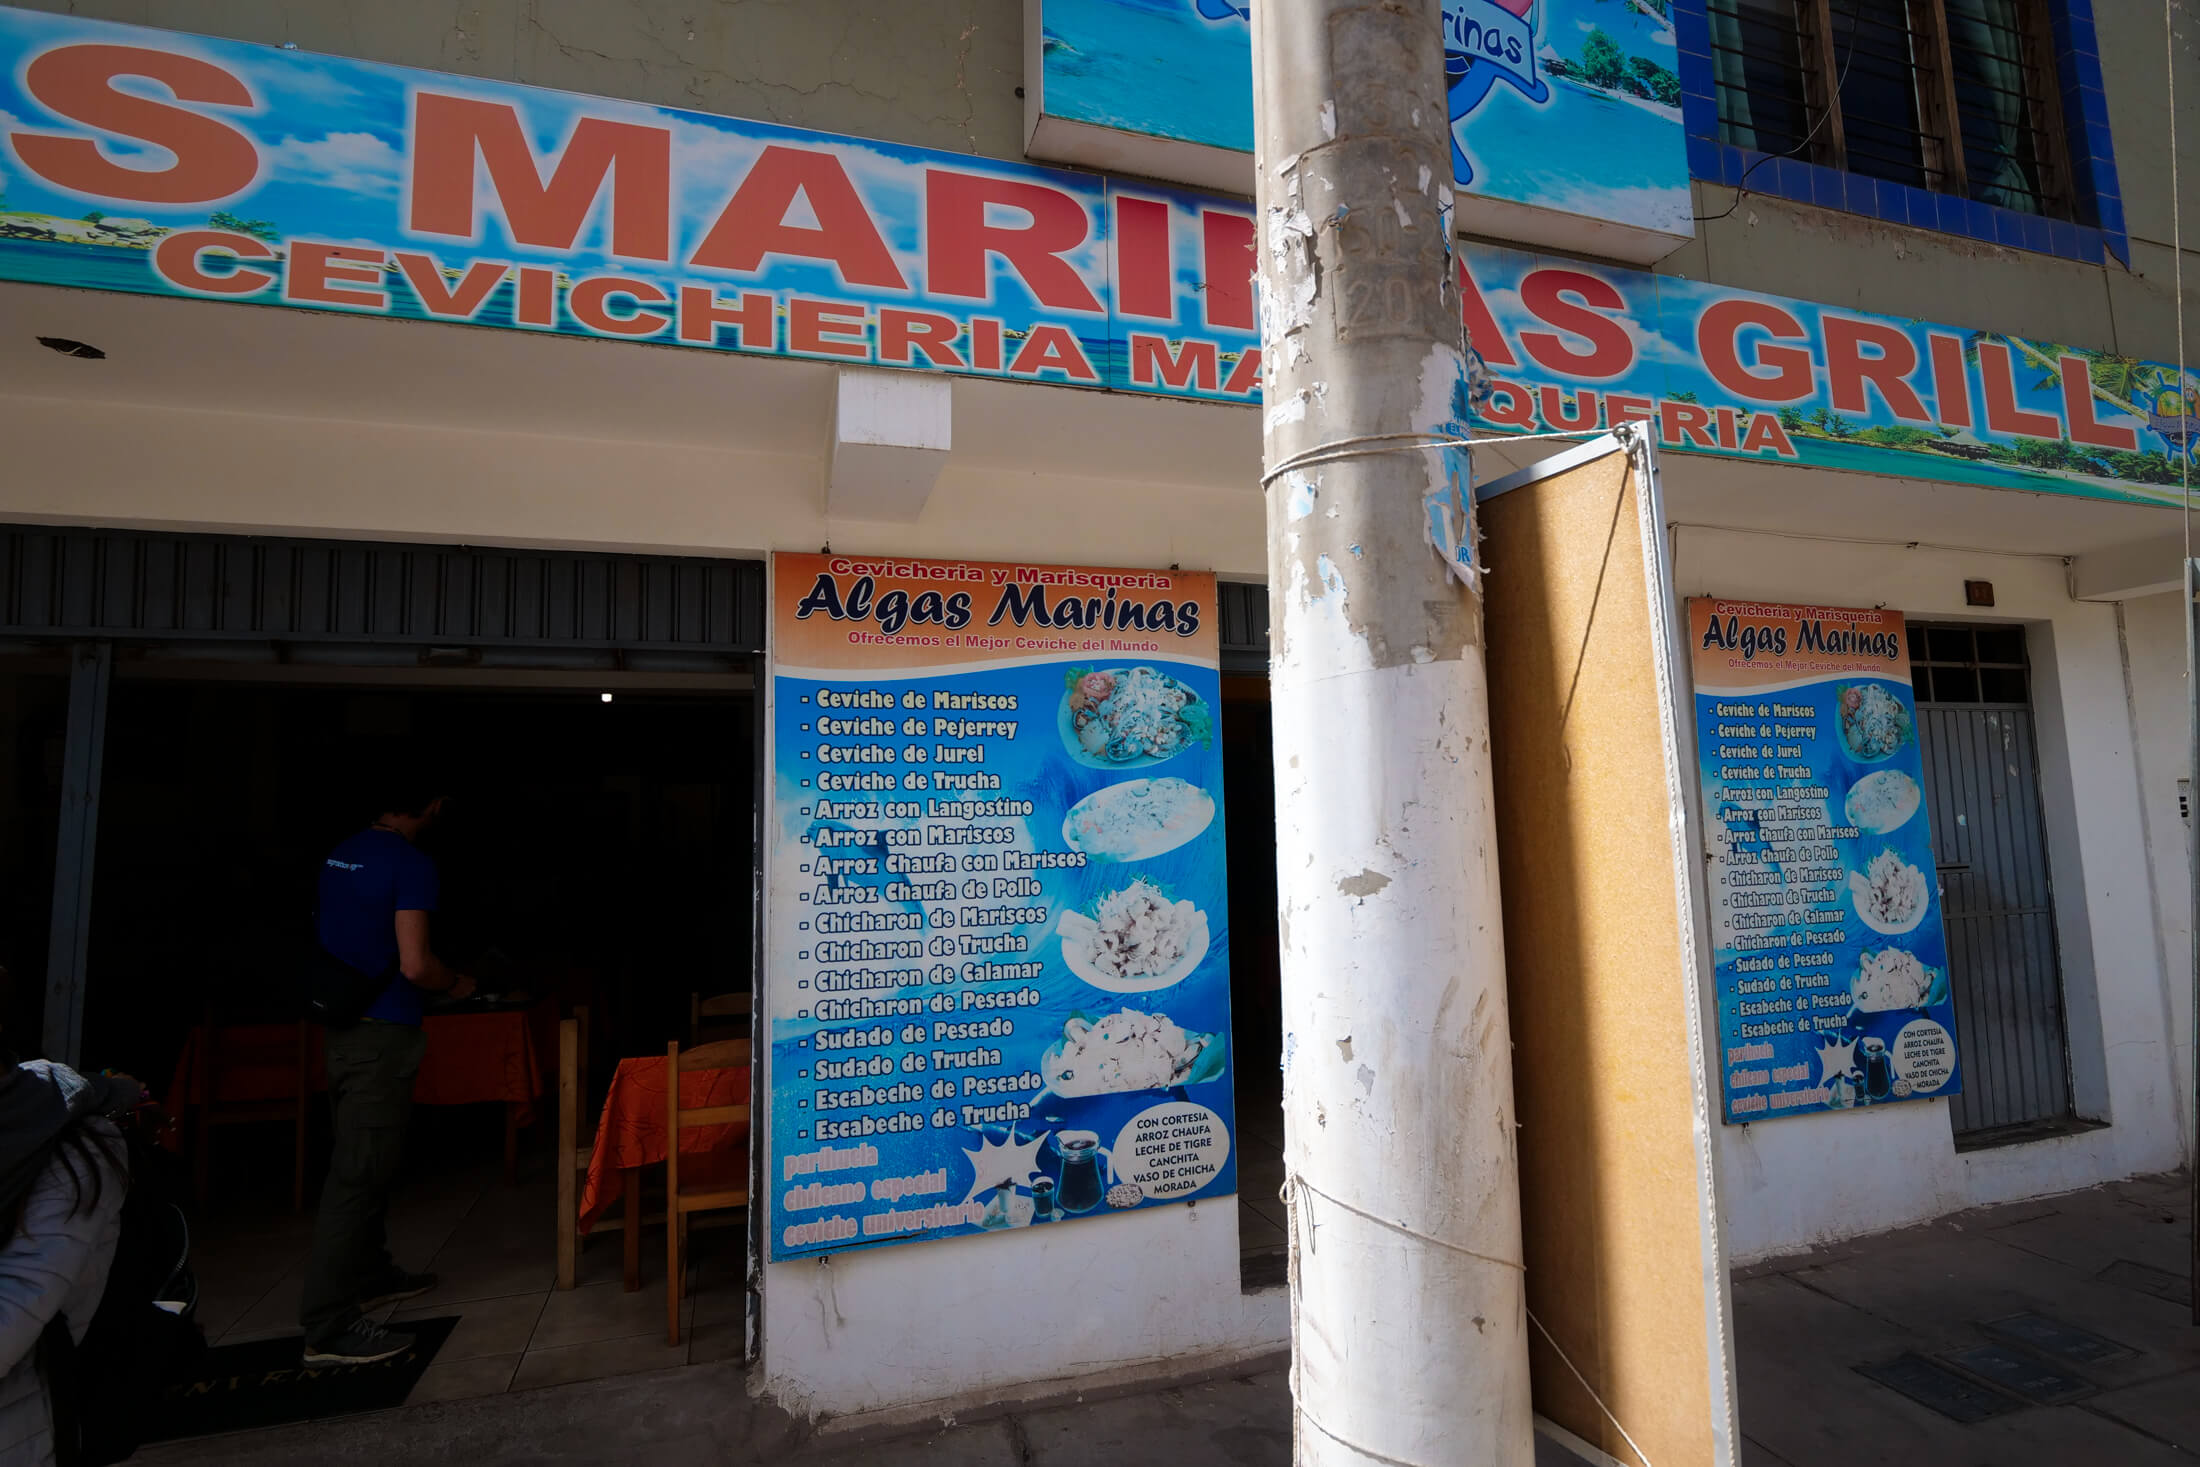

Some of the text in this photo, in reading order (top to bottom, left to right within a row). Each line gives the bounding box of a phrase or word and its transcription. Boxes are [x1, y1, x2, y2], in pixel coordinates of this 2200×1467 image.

[1441, 6, 1523, 65] rinas
[11, 43, 259, 204] S
[1697, 299, 2137, 450] GRILL
[155, 230, 1098, 382] CEVICHERIA
[830, 558, 1172, 589] Cevicheria y Marisqueria
[795, 573, 1200, 636] Algas Marinas
[1716, 602, 1882, 624] Cevicheria y Marisqueria
[848, 631, 1159, 652] Ofrecemos el Mejor Ceviche del Mundo
[1703, 614, 1899, 661] Algas Marinas
[816, 688, 1018, 710] Ceviche de Mariscos
[1716, 703, 1815, 718] Ceviche de Mariscos
[816, 716, 1018, 739] Ceviche de Pejerrey
[1718, 724, 1816, 740] Ceviche de Pejerrey
[816, 744, 984, 763] Ceviche de Jurel
[1720, 744, 1802, 758] Ceviche de Jurel
[816, 771, 1001, 791] Ceviche de Trucha
[1721, 764, 1812, 779] Ceviche de Trucha
[1722, 784, 1829, 802] Arroz con Langostino
[815, 798, 1033, 820] Arroz con Langostino
[1723, 805, 1821, 822] Arroz con Mariscos
[815, 825, 1014, 847] Arroz con Mariscos
[1725, 824, 1860, 844] Arroz Chaufa con Mariscos
[814, 850, 1087, 876] Arroz Chaufa con Mariscos
[1726, 845, 1839, 865] Arroz Chaufa de Pollo
[1729, 867, 1843, 887] Chicharon de Mariscos
[814, 877, 1042, 905] Arroz Chaufa de Pollo
[1731, 887, 1836, 908] Chicharon de Trucha
[815, 904, 1047, 933] Chicharon de Mariscos
[1732, 908, 1845, 930] Chicharon de Calamar
[815, 932, 1028, 963] Chicharon de Trucha
[1734, 928, 1846, 951] Chicharon de Pescado
[1736, 951, 1834, 973] Sudado de Pescado
[815, 961, 1043, 992] Chicharon de Calamar
[1737, 972, 1830, 994] Sudado de Trucha
[815, 986, 1041, 1021] Chicharon de Pescado
[1740, 990, 1852, 1017] Escabeche de Pescado
[814, 1017, 1013, 1050] Sudado de Pescado
[1741, 1013, 1848, 1039] Escabeche de Trucha
[814, 1047, 1001, 1080] Sudado de Trucha
[815, 1070, 1043, 1111] Escabeche de Pescado
[815, 1101, 1031, 1141] Escabeche de Trucha
[1137, 1112, 1209, 1129] CON CORTESIA
[1135, 1125, 1211, 1143] ARROZ CHAUFA
[1135, 1138, 1212, 1156] LECHE DE TIGRE
[1149, 1152, 1200, 1168] CANCHITA
[1133, 1164, 1215, 1183] VASO DE CHICHA
[1154, 1180, 1197, 1194] MORADA
